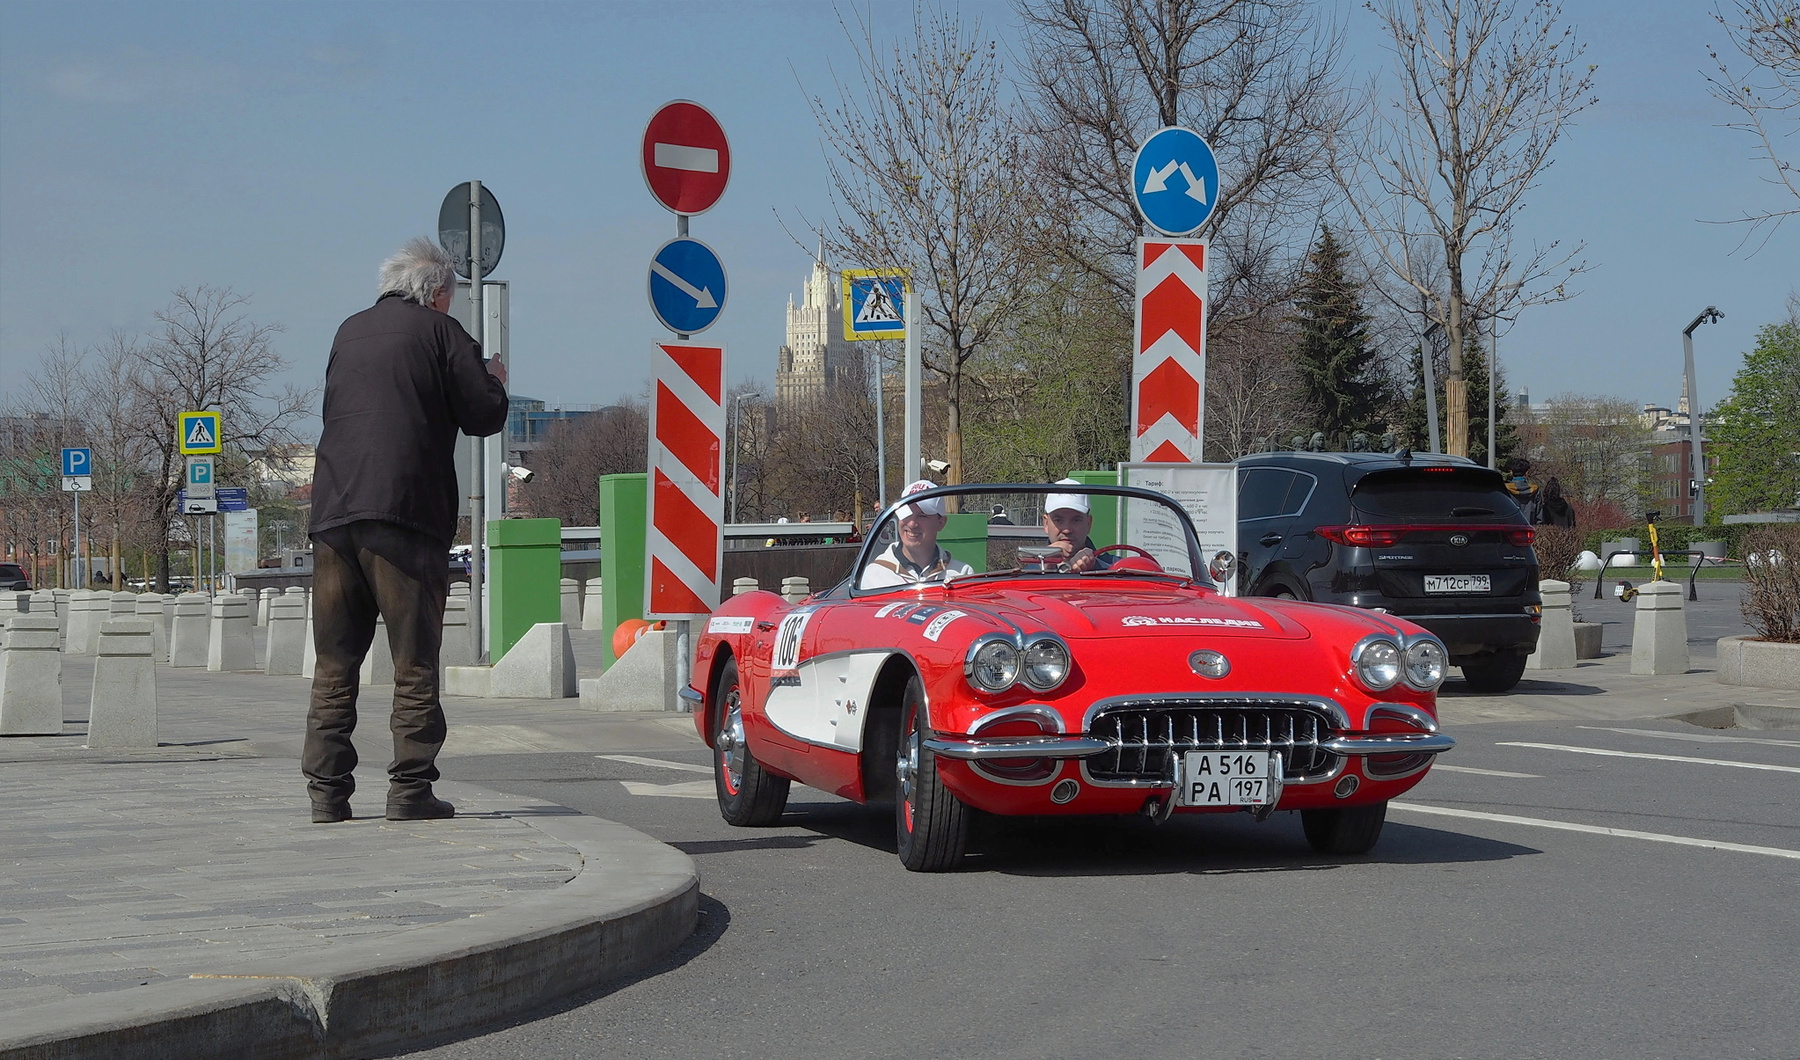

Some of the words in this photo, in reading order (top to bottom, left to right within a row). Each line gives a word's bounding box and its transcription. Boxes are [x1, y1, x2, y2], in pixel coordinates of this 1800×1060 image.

[1471, 576, 1488, 586] 799
[777, 616, 804, 666] 106
[1220, 755, 1256, 775] 516
[1234, 780, 1263, 797] 197
